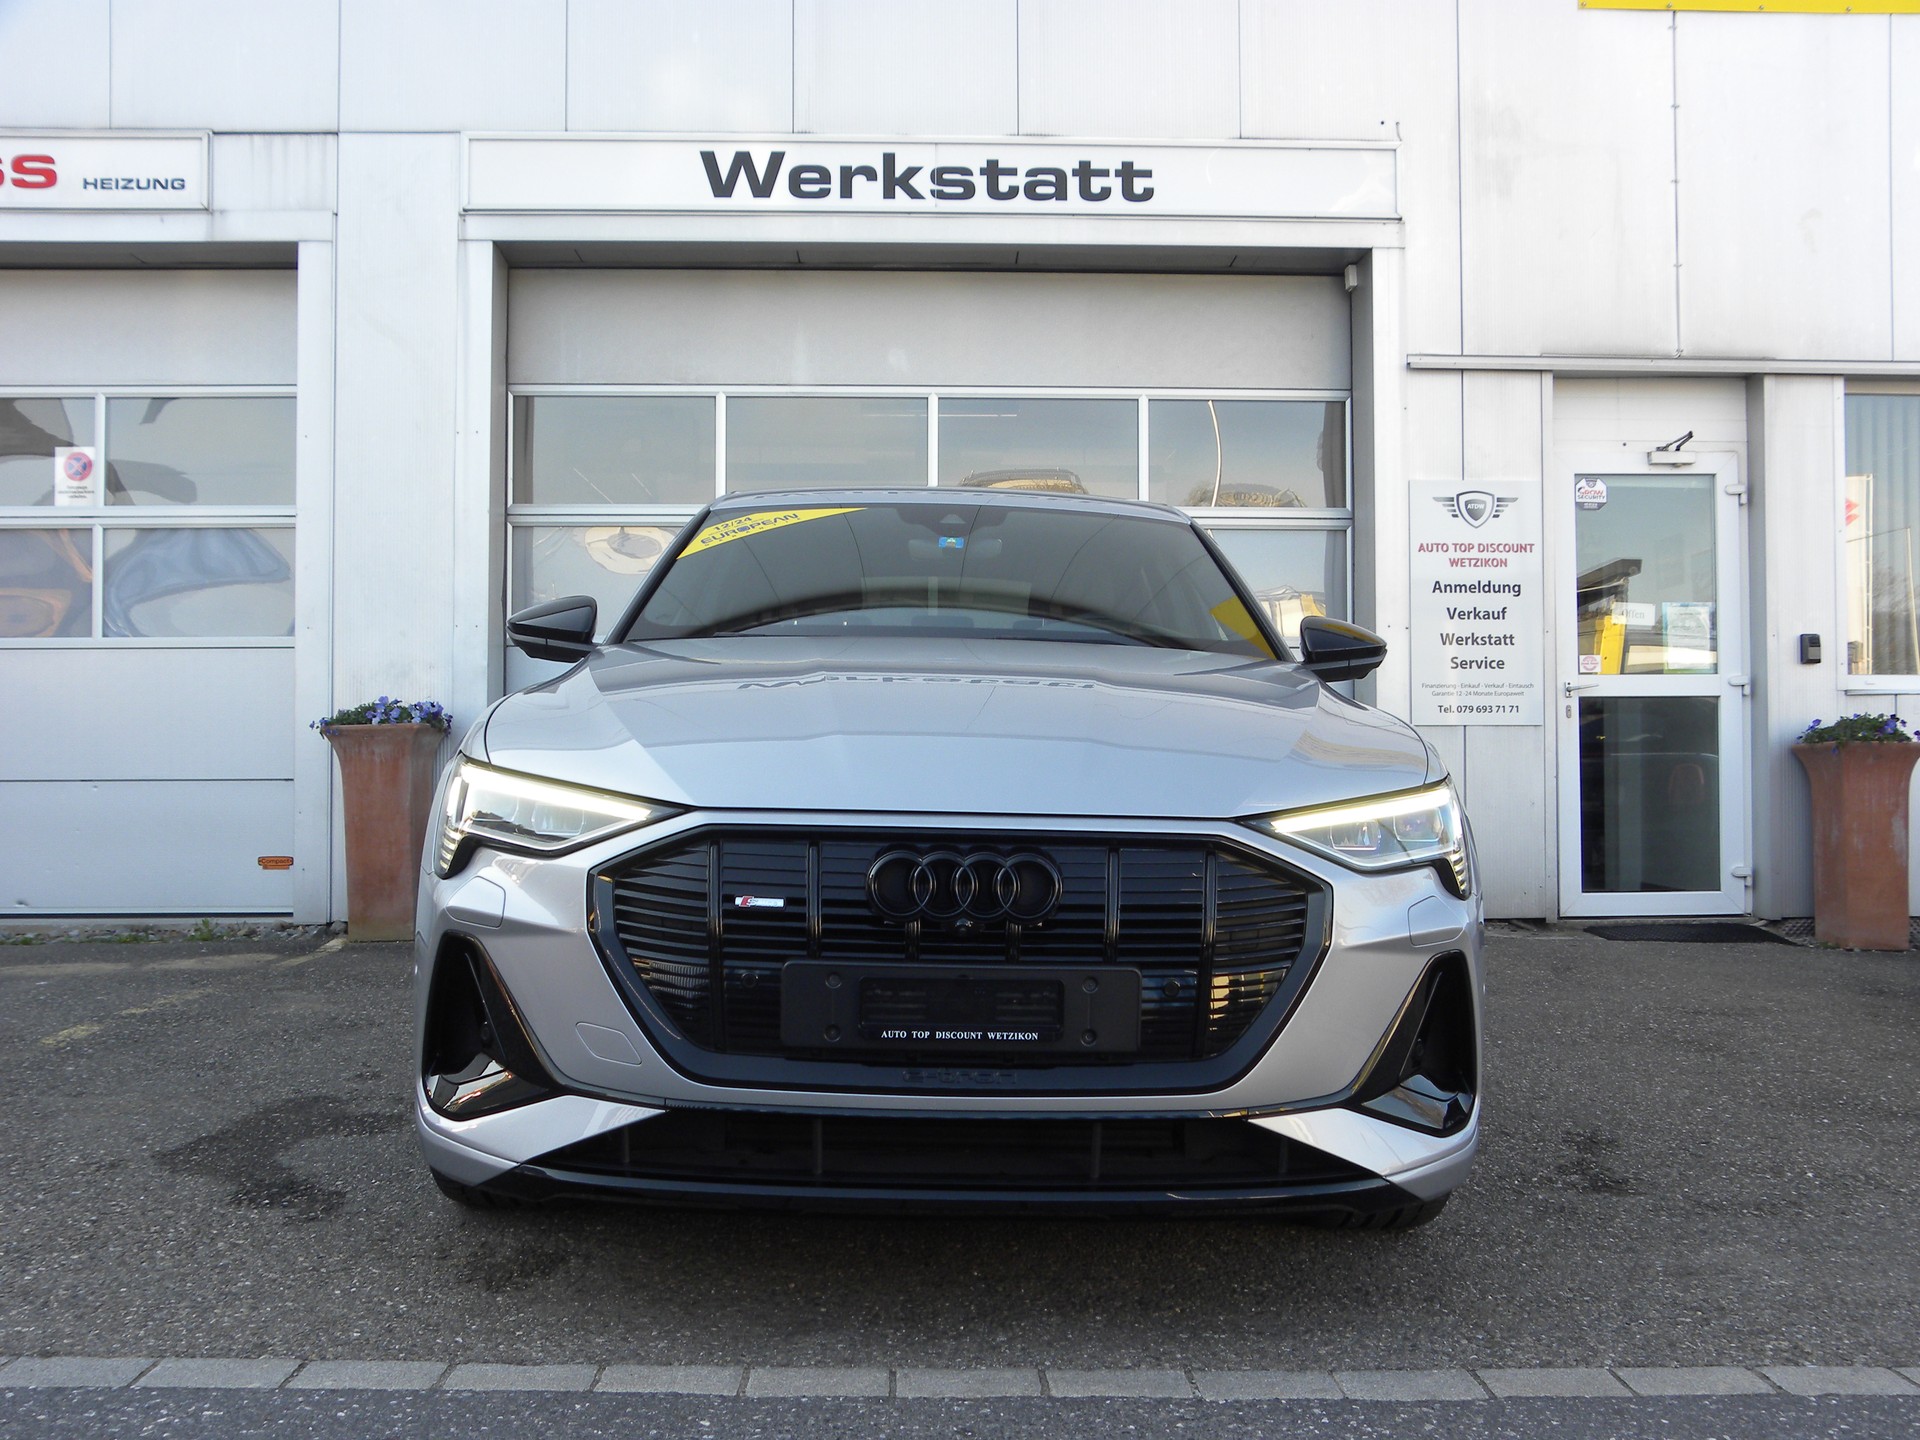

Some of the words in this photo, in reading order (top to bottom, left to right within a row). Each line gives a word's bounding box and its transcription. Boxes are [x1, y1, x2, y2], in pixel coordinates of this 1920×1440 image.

[0, 154, 57, 189] S
[83, 177, 186, 190] HEIZUNG
[699, 150, 1155, 202] Werkstatt
[701, 514, 798, 543] EUROPEAN
[715, 517, 752, 530] 12/24
[1418, 543, 1449, 553] AUTO
[1452, 543, 1475, 553] TOP
[1478, 543, 1535, 553] DISCOUNT
[1449, 558, 1508, 568] WETZIKON
[1432, 580, 1521, 597] Anmeldung
[1447, 606, 1507, 620] Verkauf
[1440, 632, 1515, 646] Werkstatt
[1450, 656, 1505, 670] Service
[1438, 705, 1454, 714] Tel.
[1457, 705, 1474, 714] 079
[1476, 705, 1493, 714] 693
[1496, 705, 1506, 714] 71
[1509, 705, 1520, 714] 71
[881, 1030, 907, 1039] AUTO
[911, 1030, 930, 1039] TOP
[935, 1031, 982, 1040] DISCOUNT
[987, 1032, 1039, 1041] WETZIKON
